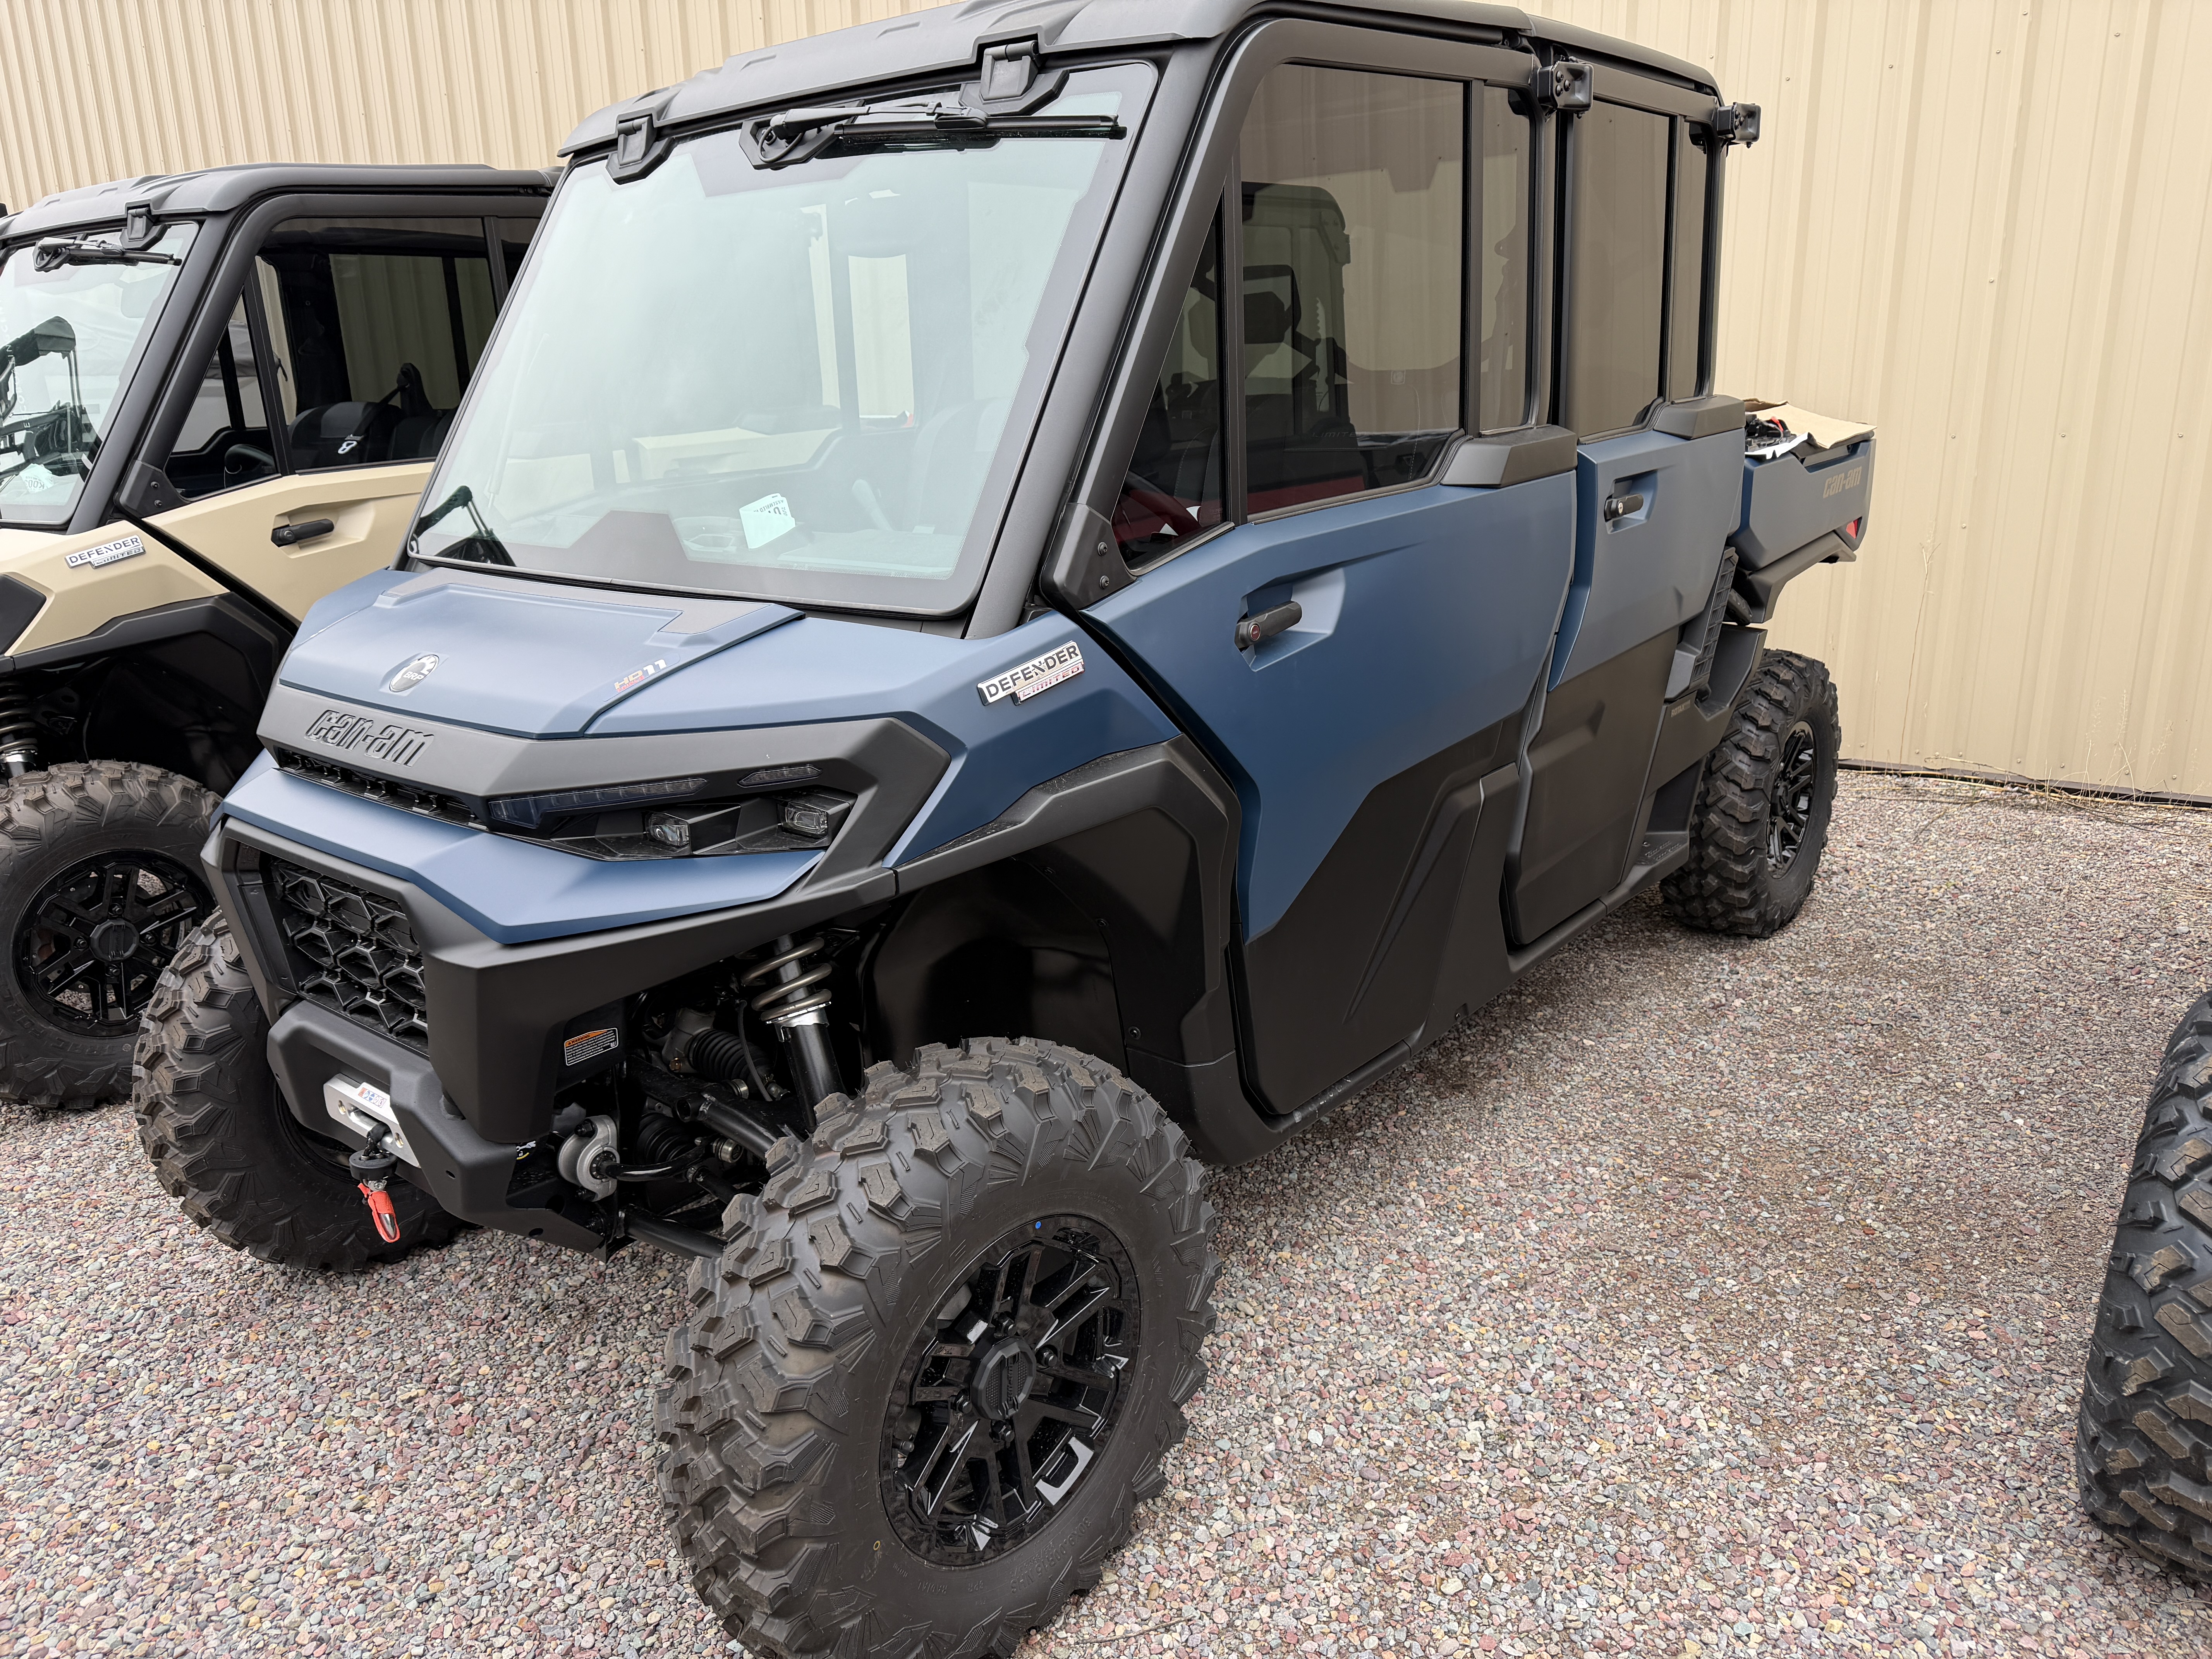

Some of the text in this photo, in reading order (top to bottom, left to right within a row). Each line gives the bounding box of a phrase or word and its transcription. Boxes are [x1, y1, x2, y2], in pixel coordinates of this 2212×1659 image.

[1823, 466, 1862, 499] can-am
[69, 538, 139, 563] DEFENDER
[403, 671, 424, 680] BRP
[614, 659, 666, 690] HD11
[986, 645, 1079, 698] DEFENDER
[304, 709, 434, 768] can-am
